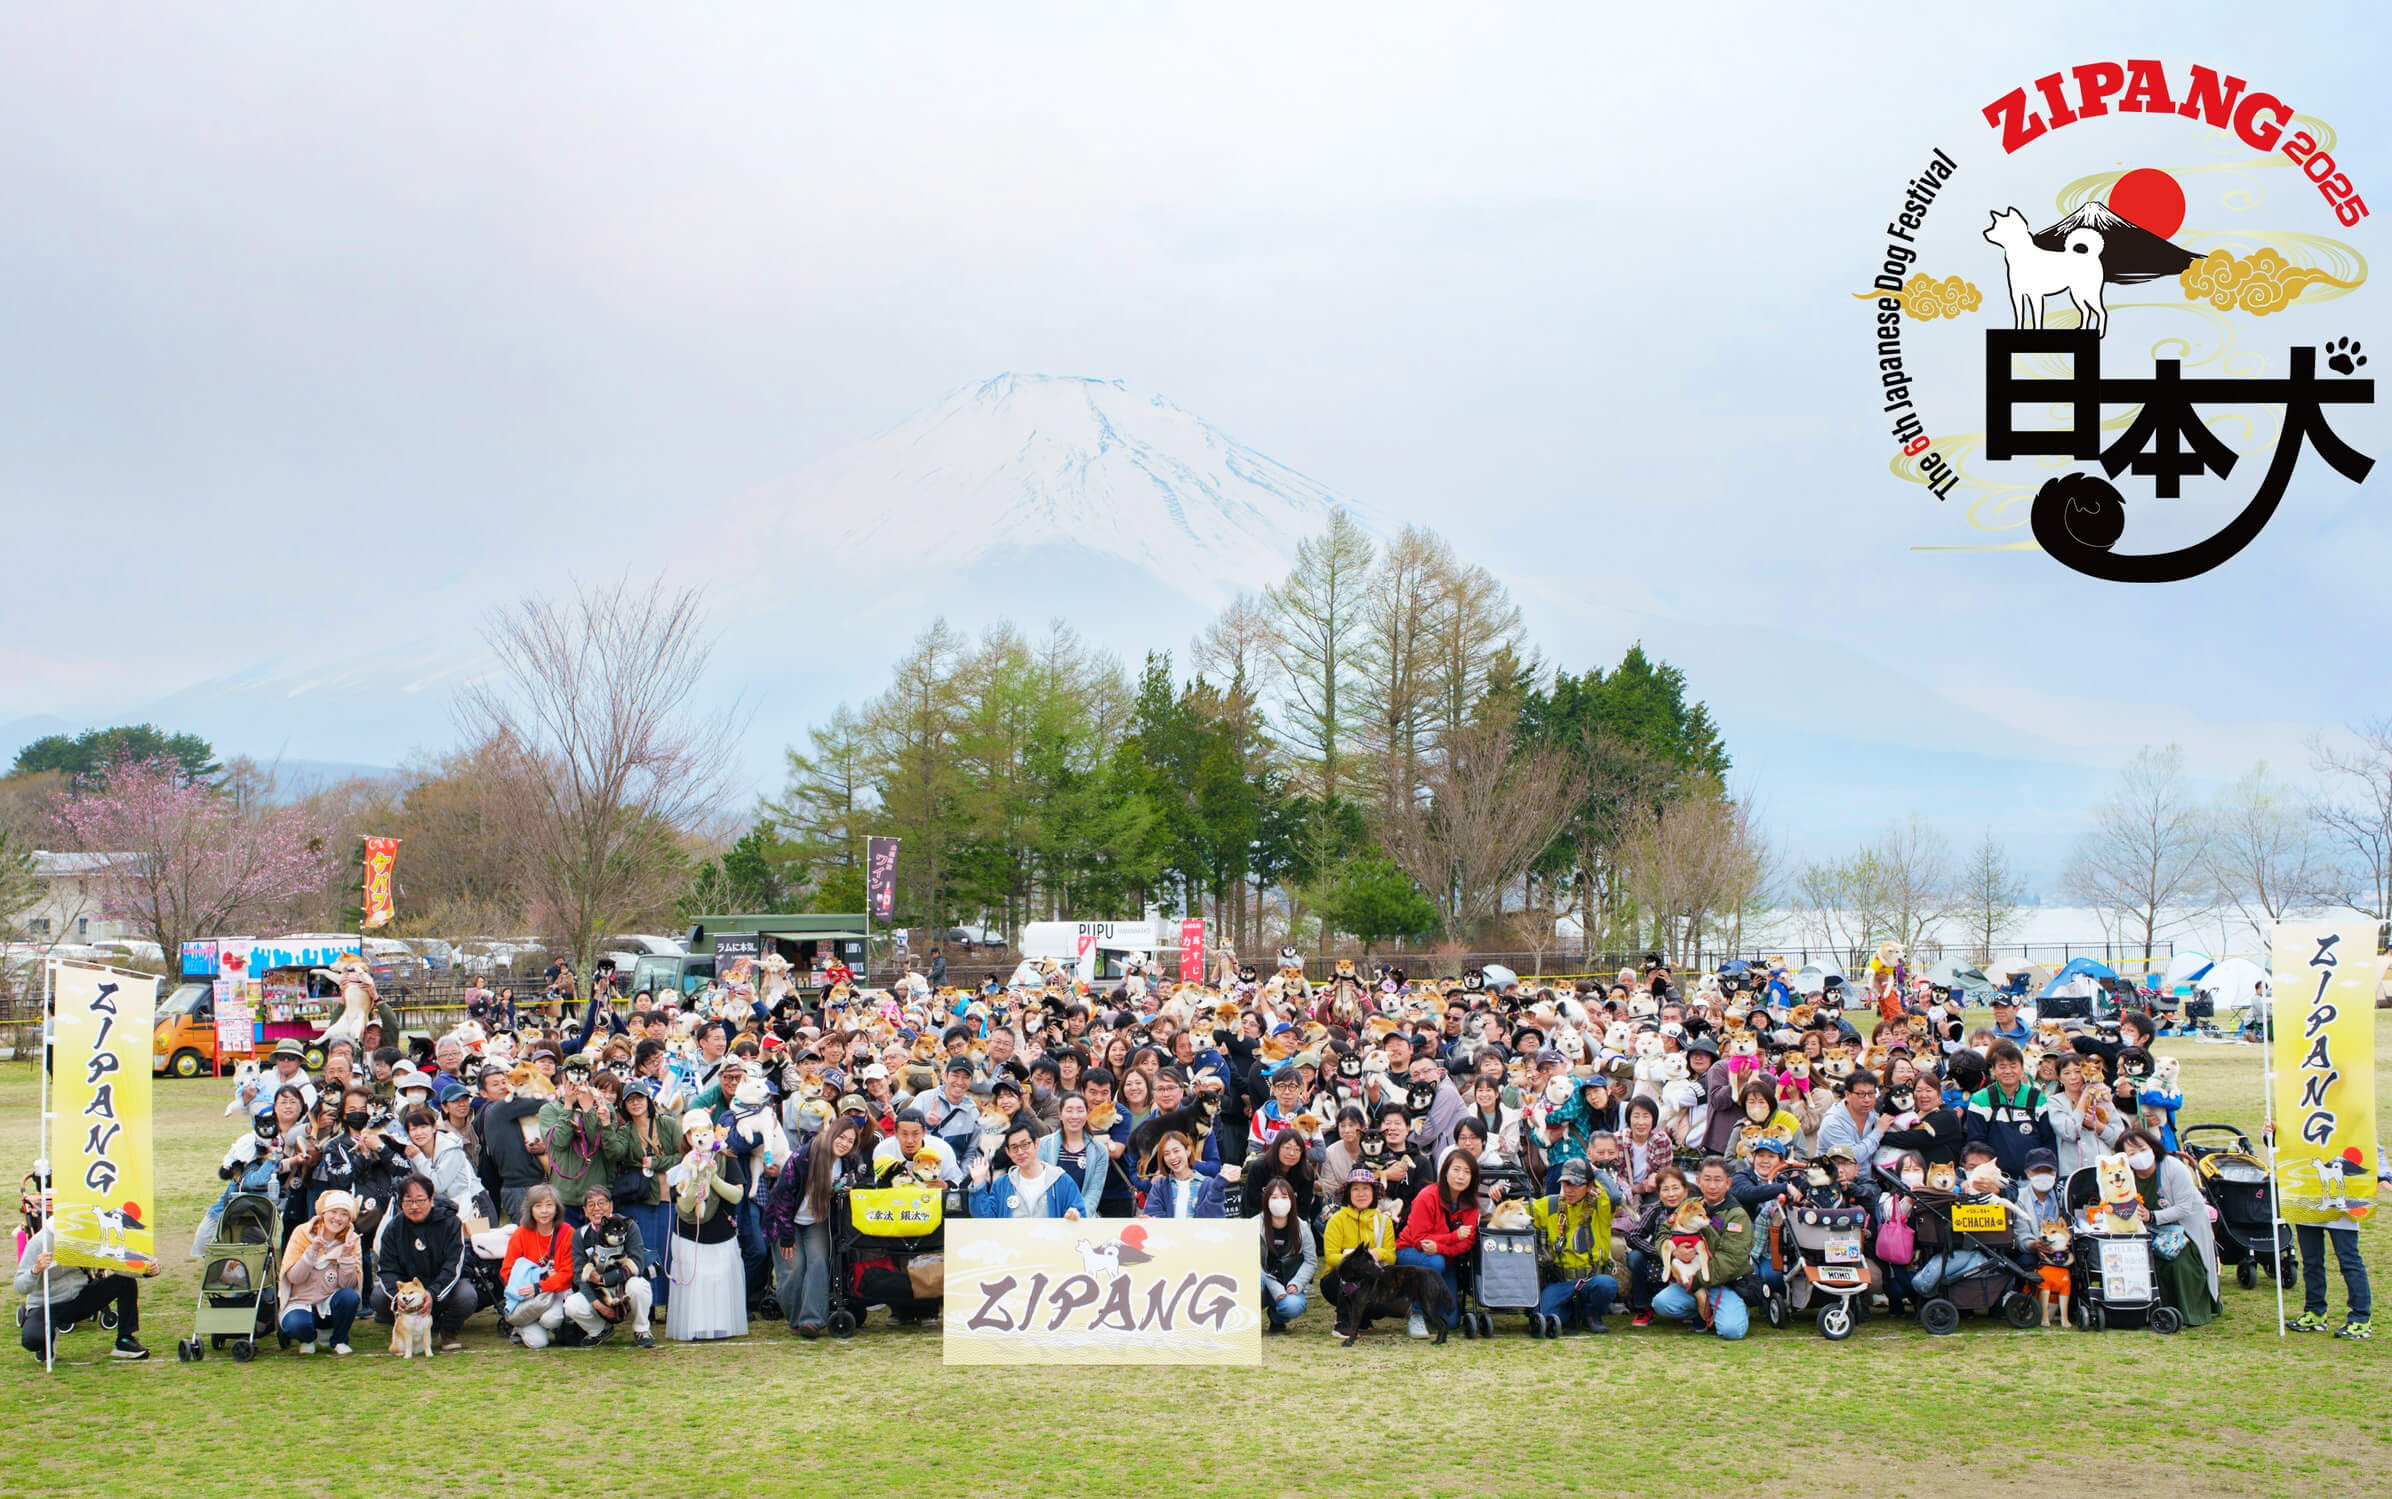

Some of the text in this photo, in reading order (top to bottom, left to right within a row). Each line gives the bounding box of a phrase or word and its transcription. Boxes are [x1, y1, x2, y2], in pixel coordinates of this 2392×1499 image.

[370, 852, 391, 912] ケバブ
[872, 854, 888, 889] ワイン
[1079, 923, 1114, 939] PUPU
[2301, 934, 2340, 1146] ZIPANG
[84, 982, 120, 1194] ZIPANG
[1962, 1217, 1996, 1228] CHACHA
[1828, 1271, 1851, 1280] MOMO
[967, 1272, 1238, 1332] ZIPANG
